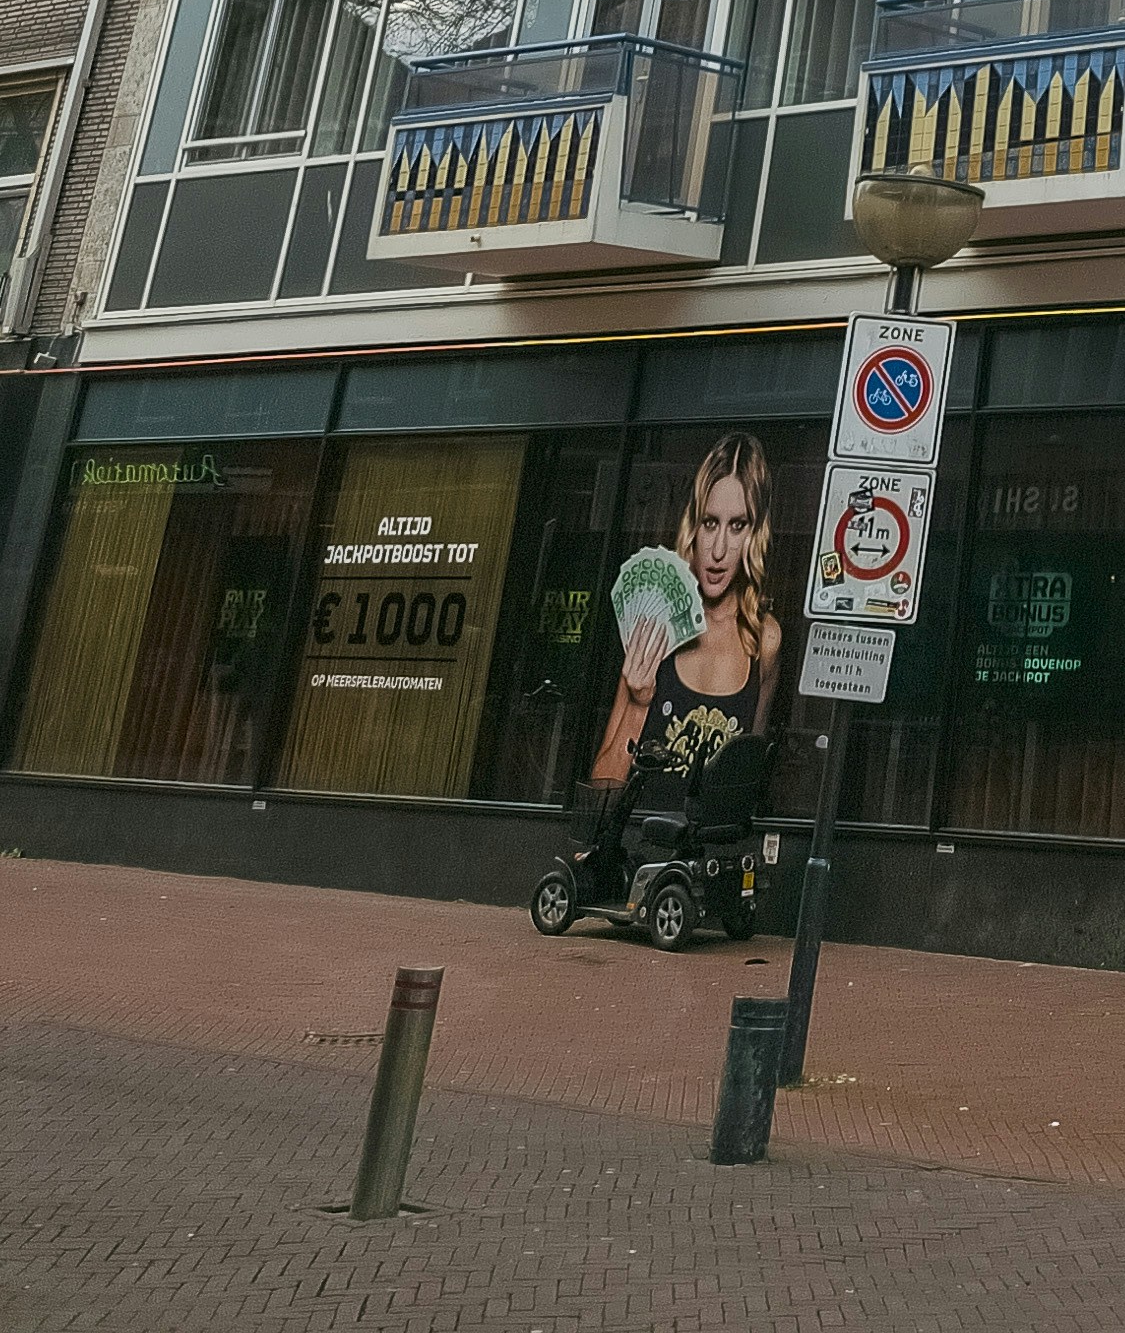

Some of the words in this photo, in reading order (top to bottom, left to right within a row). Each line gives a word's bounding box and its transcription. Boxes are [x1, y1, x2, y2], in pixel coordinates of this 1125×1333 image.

[879, 326, 924, 342] ZONE
[859, 476, 901, 492] ZONE
[378, 517, 432, 535] ALTIJD
[324, 544, 444, 564] JACKPOTBOOST
[447, 543, 478, 563] TOT
[542, 590, 592, 611] FAIR
[992, 604, 1065, 623] BONUS
[537, 610, 589, 634] PLAY
[856, 631, 890, 646] tussen
[812, 645, 885, 665] winkelsluiting
[1024, 644, 1050, 656] EEN
[830, 665, 841, 674] en
[856, 666, 862, 676] h
[1023, 657, 1082, 671] BOVENOP
[311, 675, 325, 687] OP
[326, 675, 443, 690] MEERSPELERAUTOMATEN
[974, 670, 989, 682] JE
[815, 678, 871, 693] toegestaan
